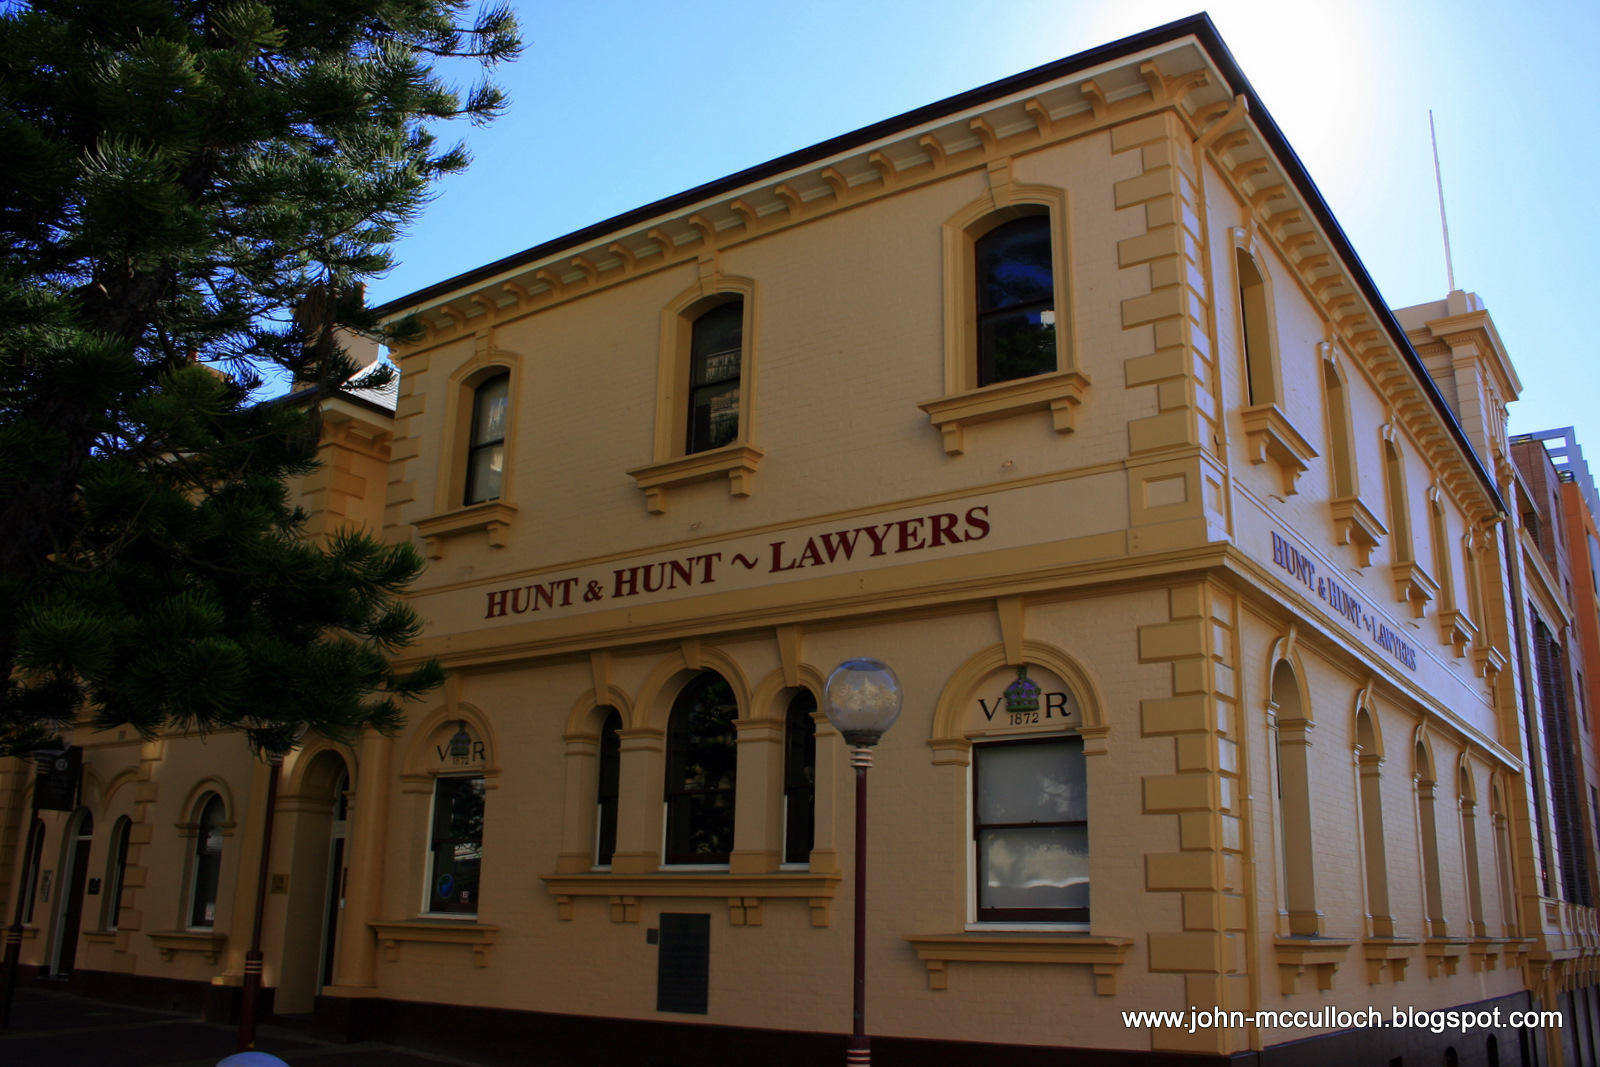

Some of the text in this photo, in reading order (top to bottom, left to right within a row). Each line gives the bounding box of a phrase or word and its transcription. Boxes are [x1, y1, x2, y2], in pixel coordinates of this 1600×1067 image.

[484, 577, 579, 619] HUNT
[582, 579, 604, 603] &
[610, 552, 722, 599] HUNT
[768, 505, 991, 573] LAWYERS
[1271, 530, 1315, 591] HUNT
[1327, 577, 1362, 629] HUNT
[978, 692, 1071, 722] V R
[1009, 712, 1039, 726] 1872
[472, 741, 486, 761] R
